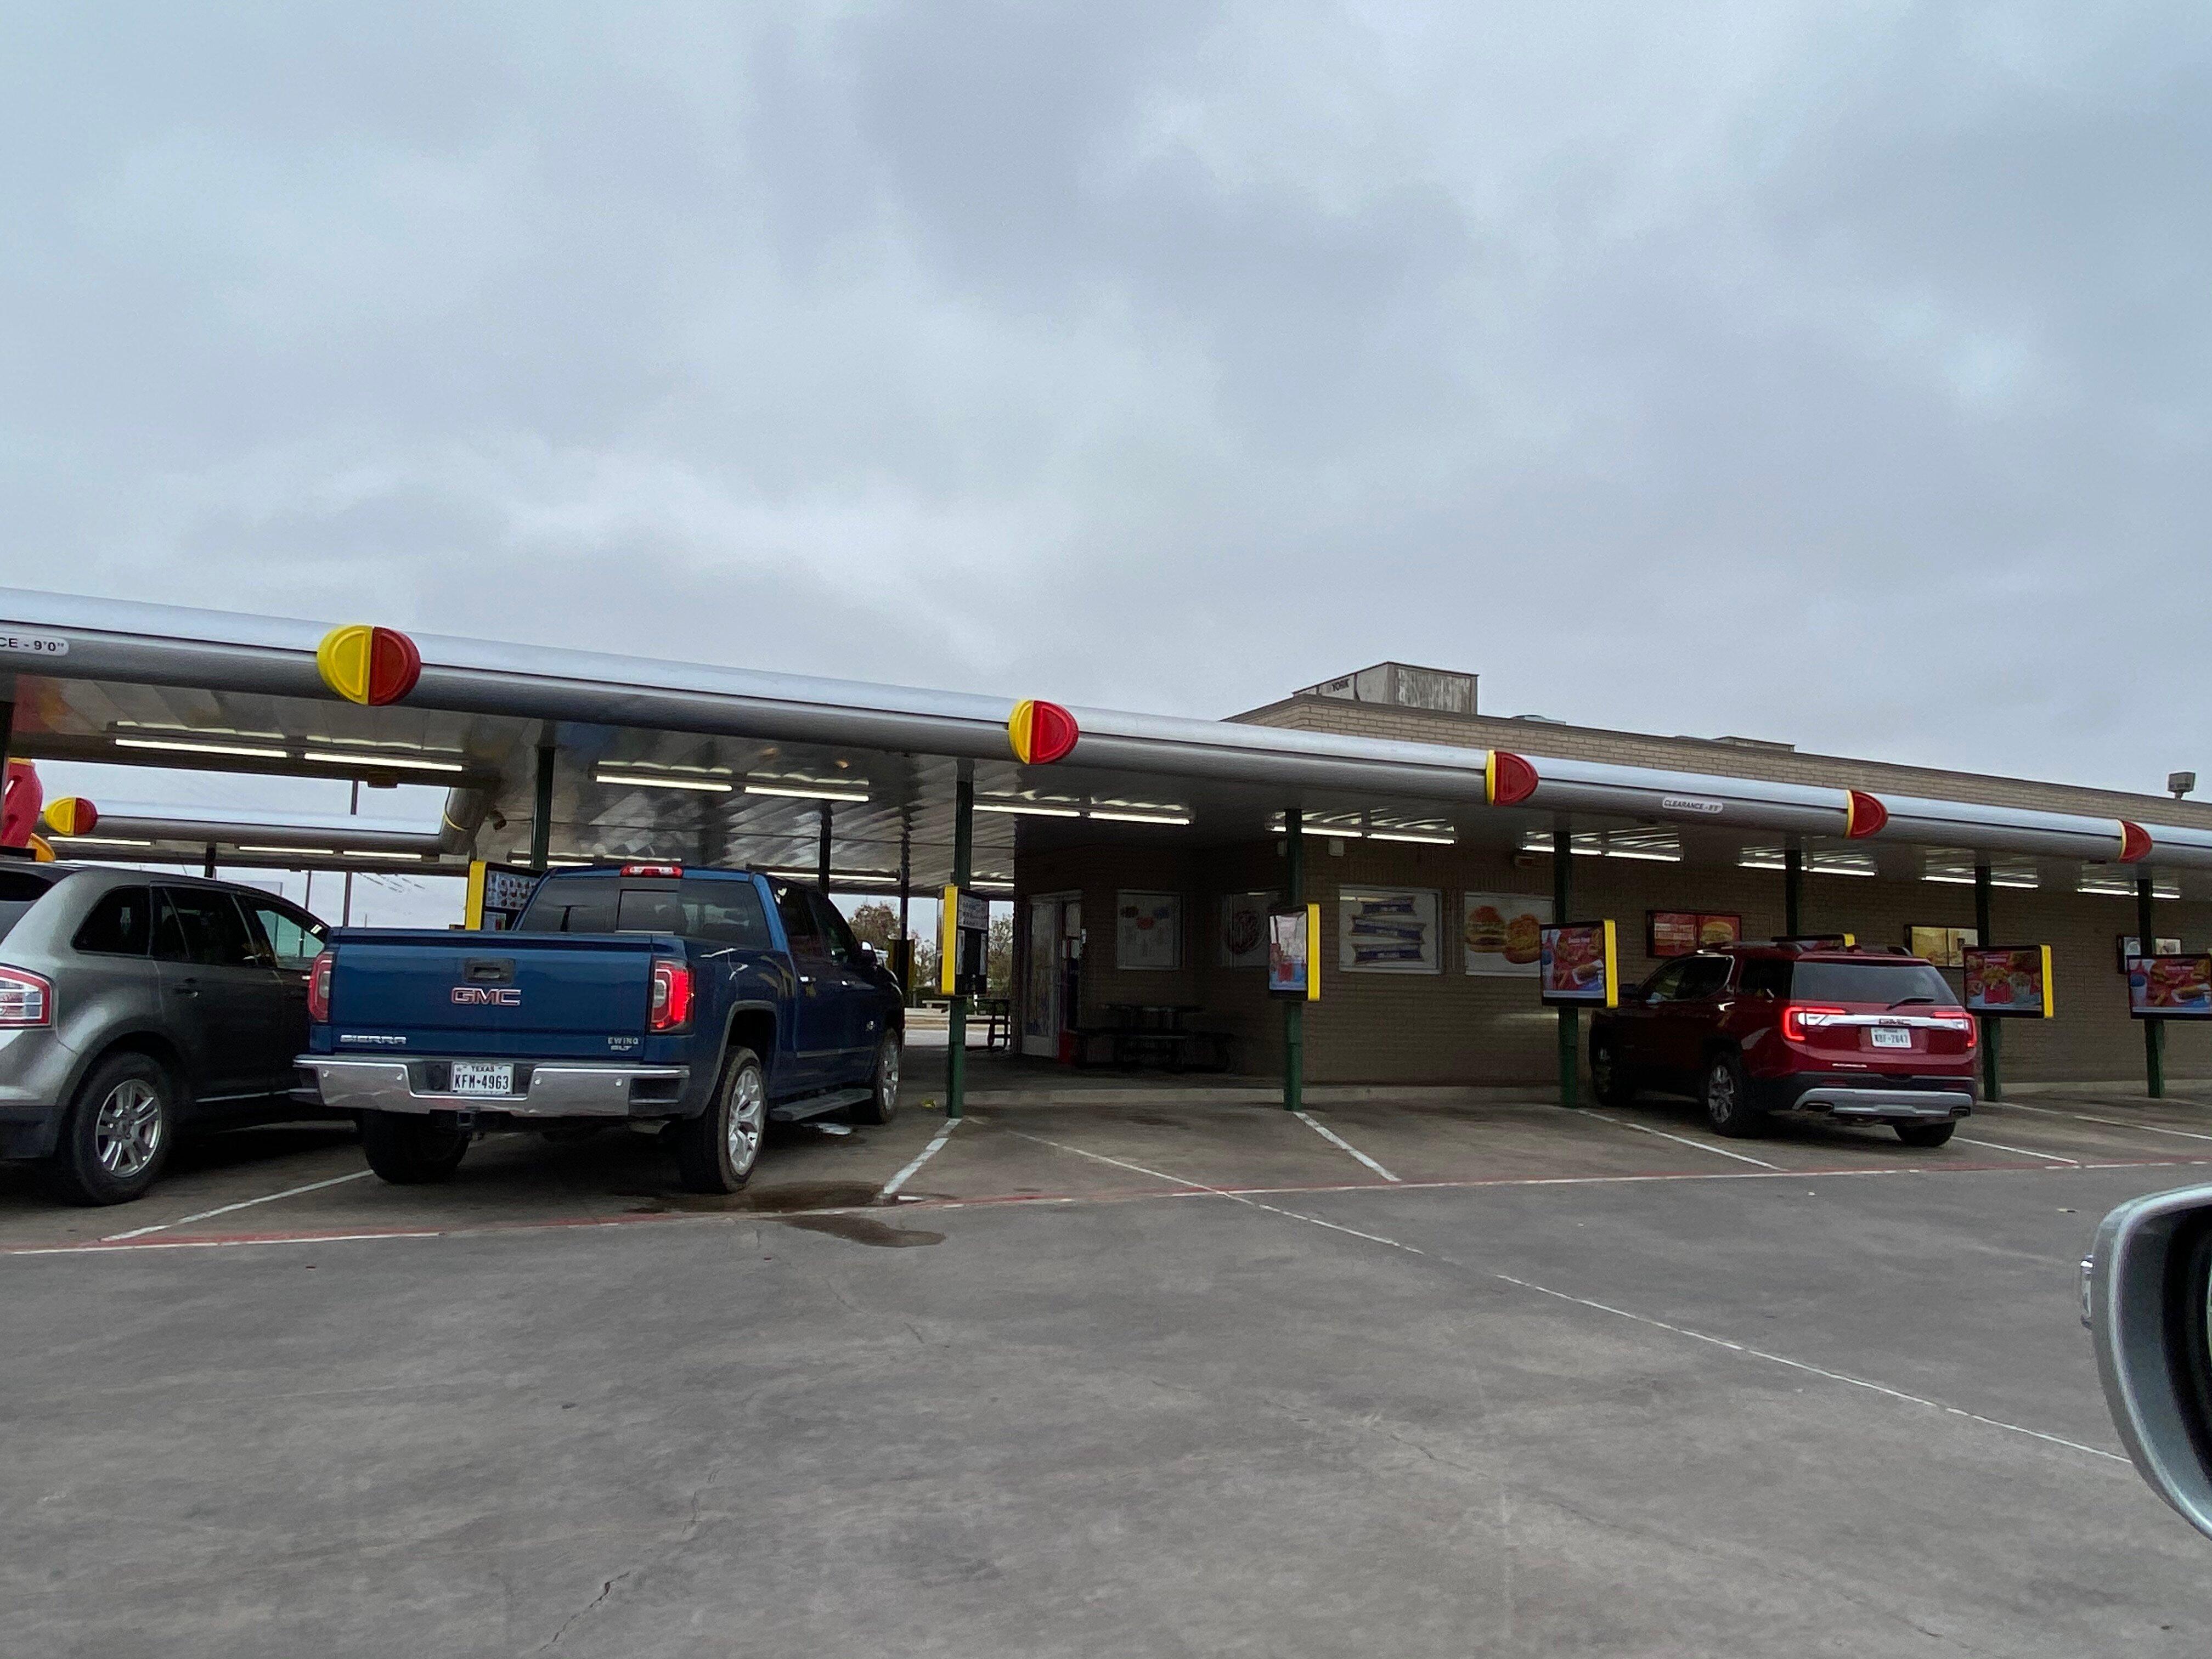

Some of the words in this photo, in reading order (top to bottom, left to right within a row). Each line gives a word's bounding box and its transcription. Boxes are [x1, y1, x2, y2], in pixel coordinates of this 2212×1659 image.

[1664, 800, 1704, 810] CLEARANCE
[452, 988, 521, 1006] GMC
[340, 1035, 407, 1044] SIERRA
